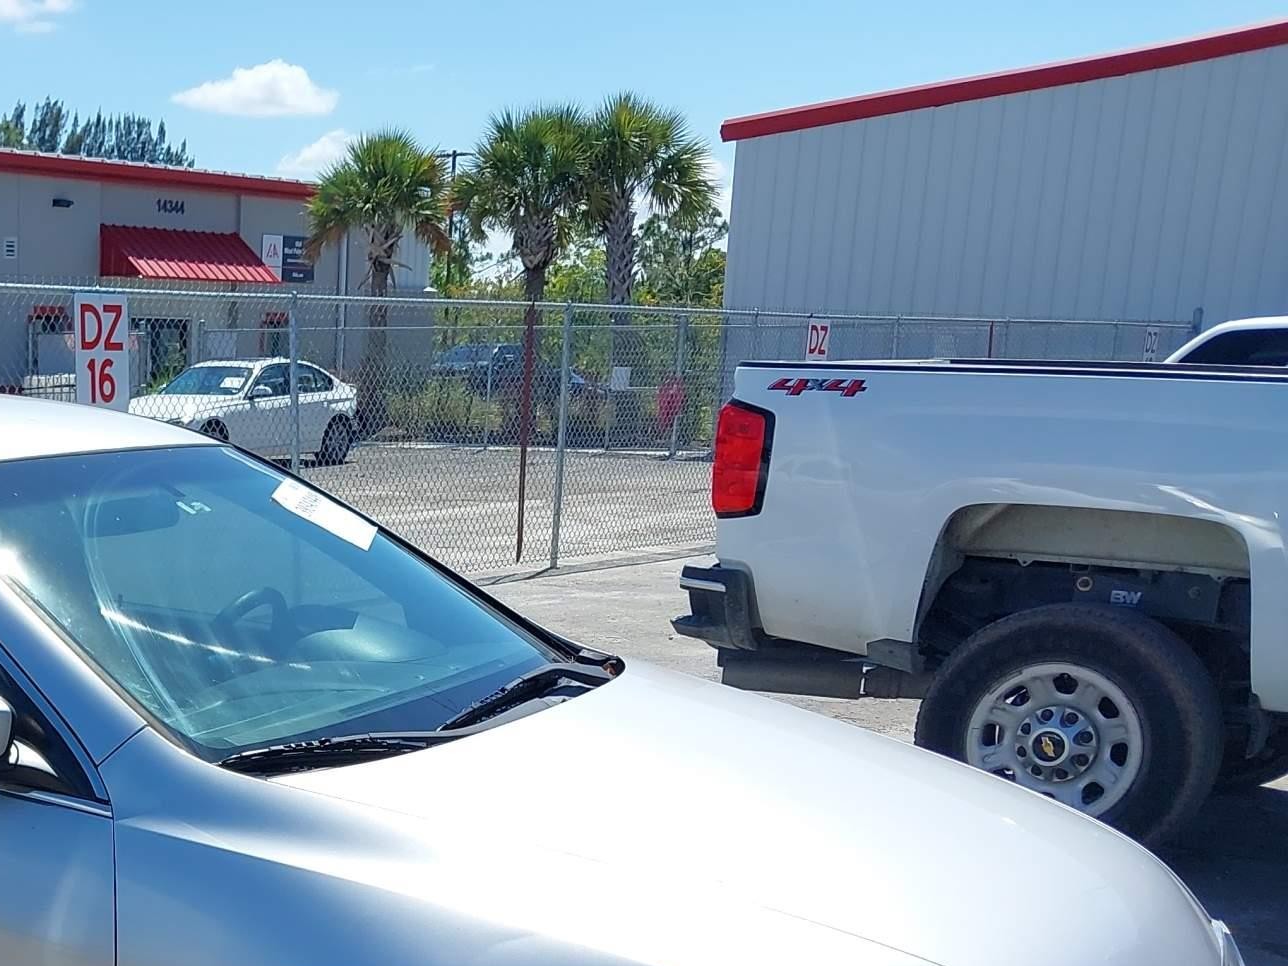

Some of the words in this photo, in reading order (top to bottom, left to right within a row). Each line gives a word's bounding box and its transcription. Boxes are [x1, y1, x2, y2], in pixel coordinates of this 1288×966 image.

[156, 198, 185, 215] 14344
[80, 304, 123, 351] DZ
[808, 325, 829, 355] DZ
[1145, 331, 1158, 353] DZ
[87, 358, 116, 404] 16
